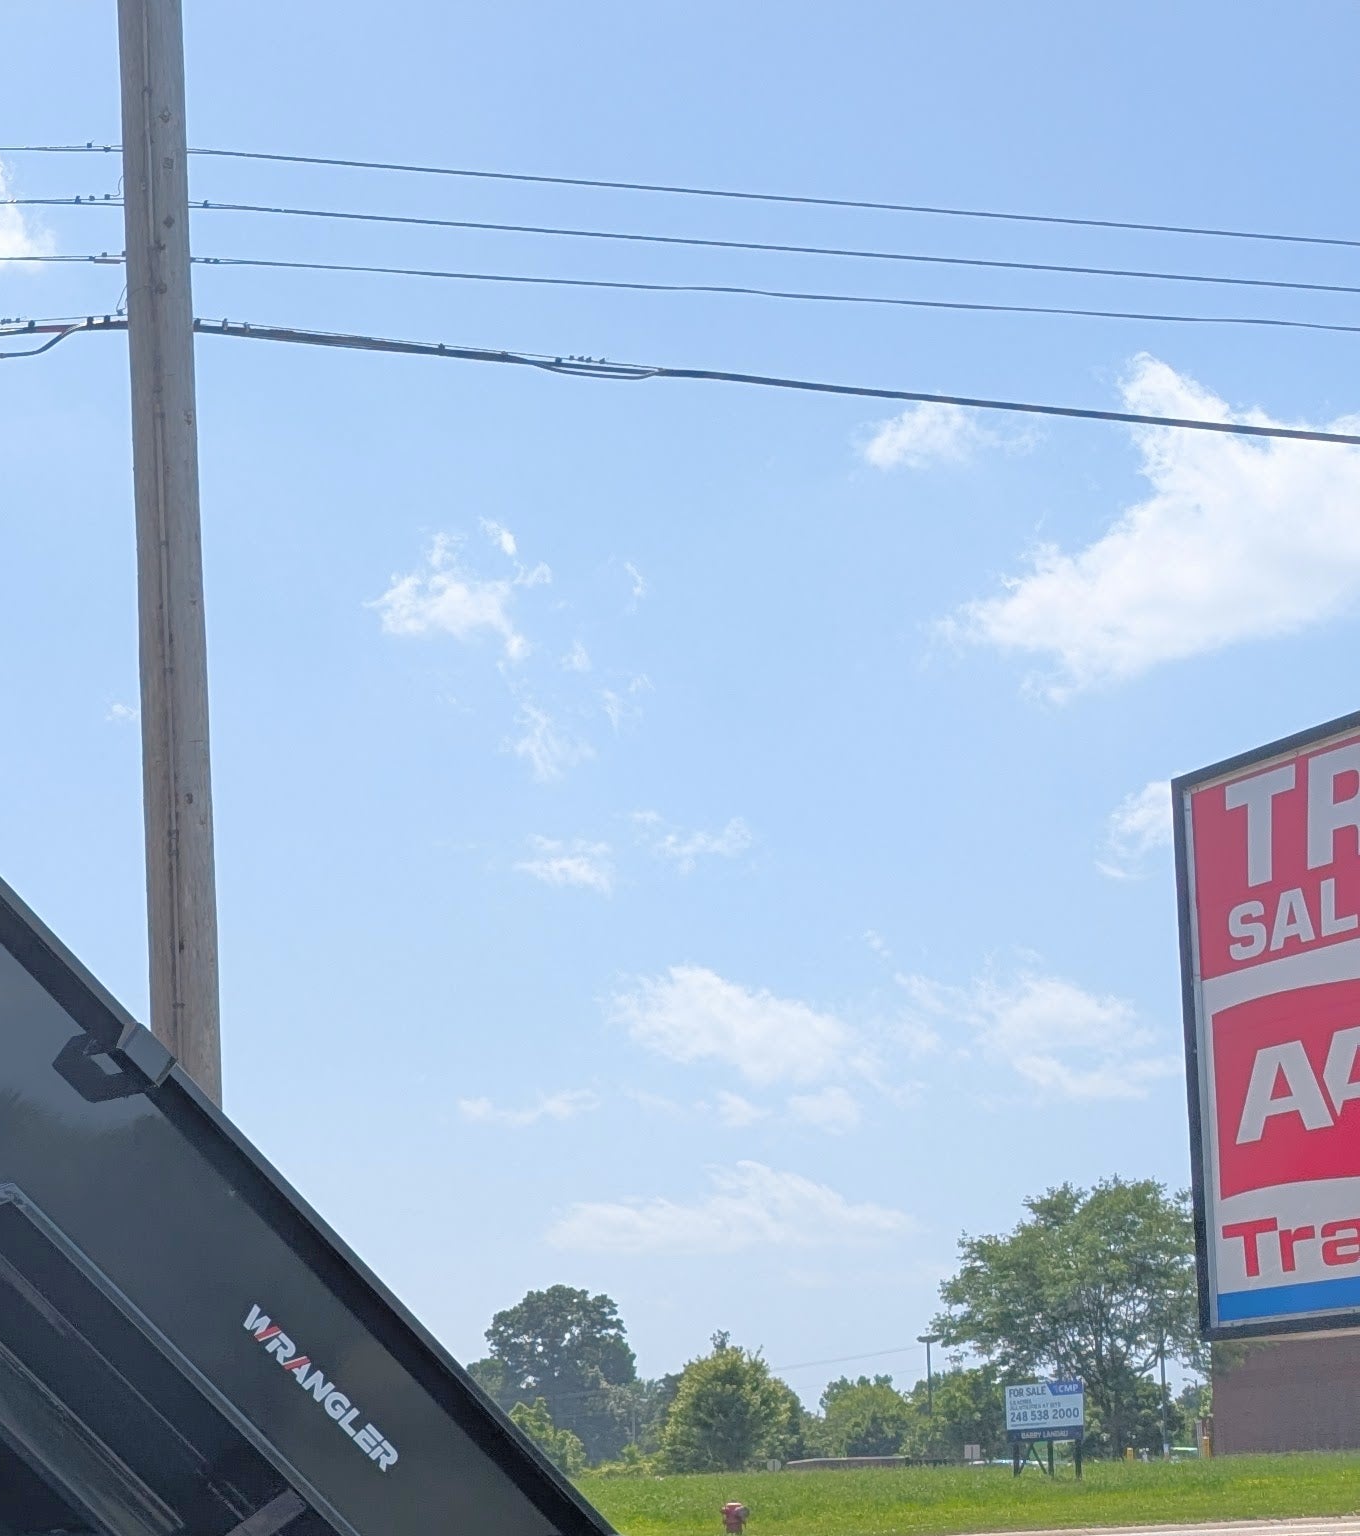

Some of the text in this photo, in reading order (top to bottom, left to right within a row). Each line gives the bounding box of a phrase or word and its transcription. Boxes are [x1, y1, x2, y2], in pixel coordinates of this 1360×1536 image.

[1228, 878, 1359, 961] SAL
[1221, 1216, 1360, 1278] Tra
[243, 1303, 399, 1473] WRANGLER
[1008, 1385, 1047, 1398] FOR SALE
[1010, 1407, 1080, 1423] 248 538 2000
